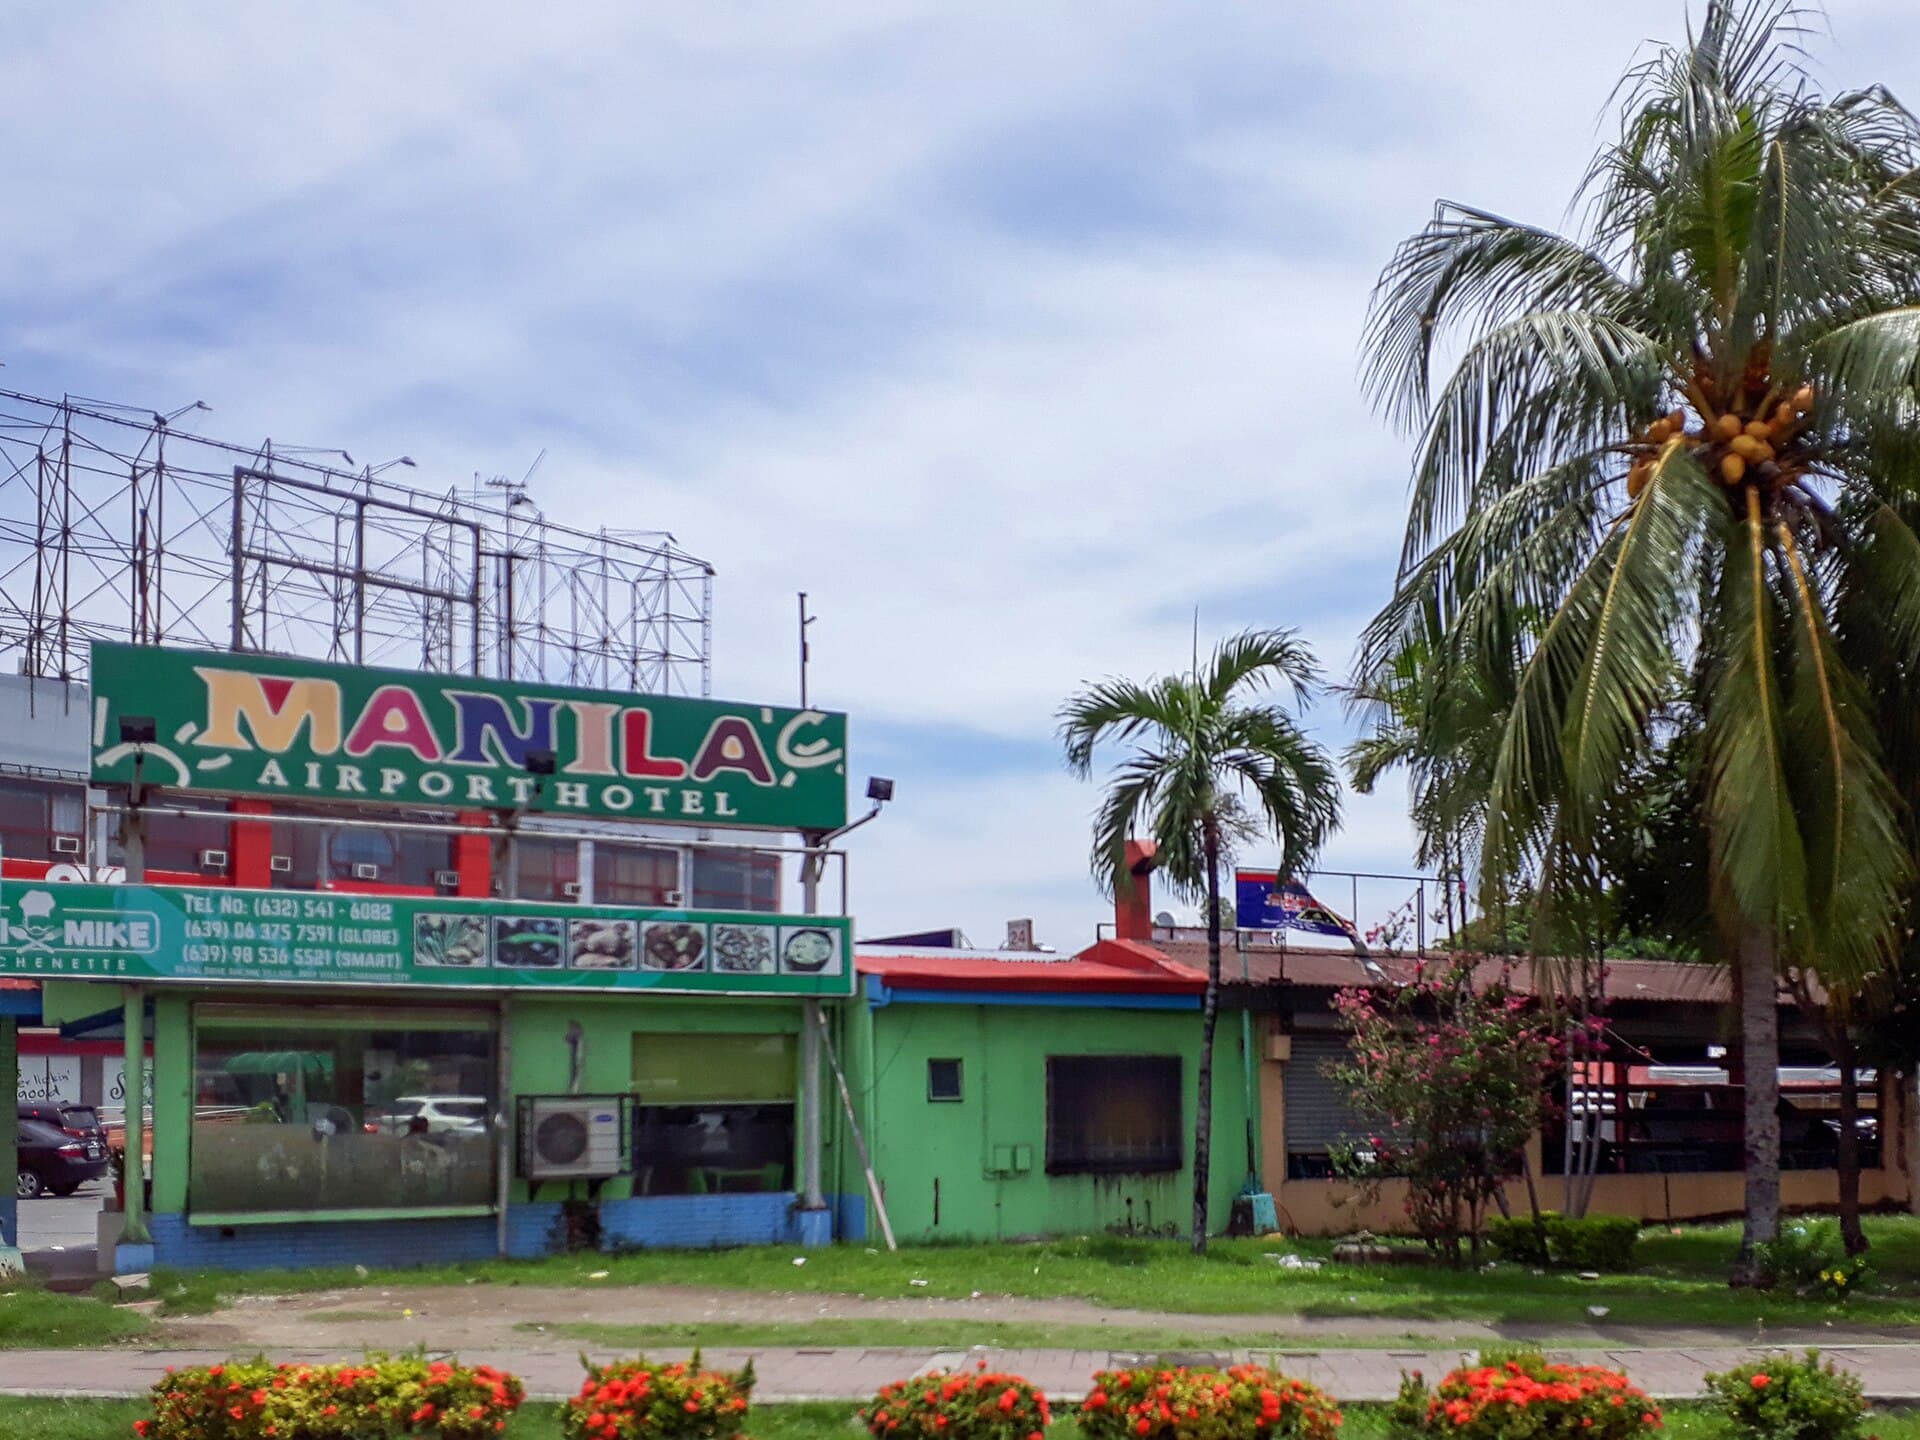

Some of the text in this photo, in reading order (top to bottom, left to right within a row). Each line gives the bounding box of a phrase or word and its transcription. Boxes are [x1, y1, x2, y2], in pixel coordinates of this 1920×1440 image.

[193, 666, 777, 787] MANILA
[257, 758, 738, 817] AIRPORT HOTEL
[253, 897, 299, 919] (632)
[304, 900, 334, 919] 541
[350, 902, 393, 921] 6082
[63, 919, 150, 948] MIKE
[184, 919, 399, 946] (639) 06 375 7591 (GLOBE)
[182, 944, 226, 964] (639)
[231, 946, 253, 964] 98
[259, 947, 289, 966] 536
[335, 950, 402, 969] (SMART)
